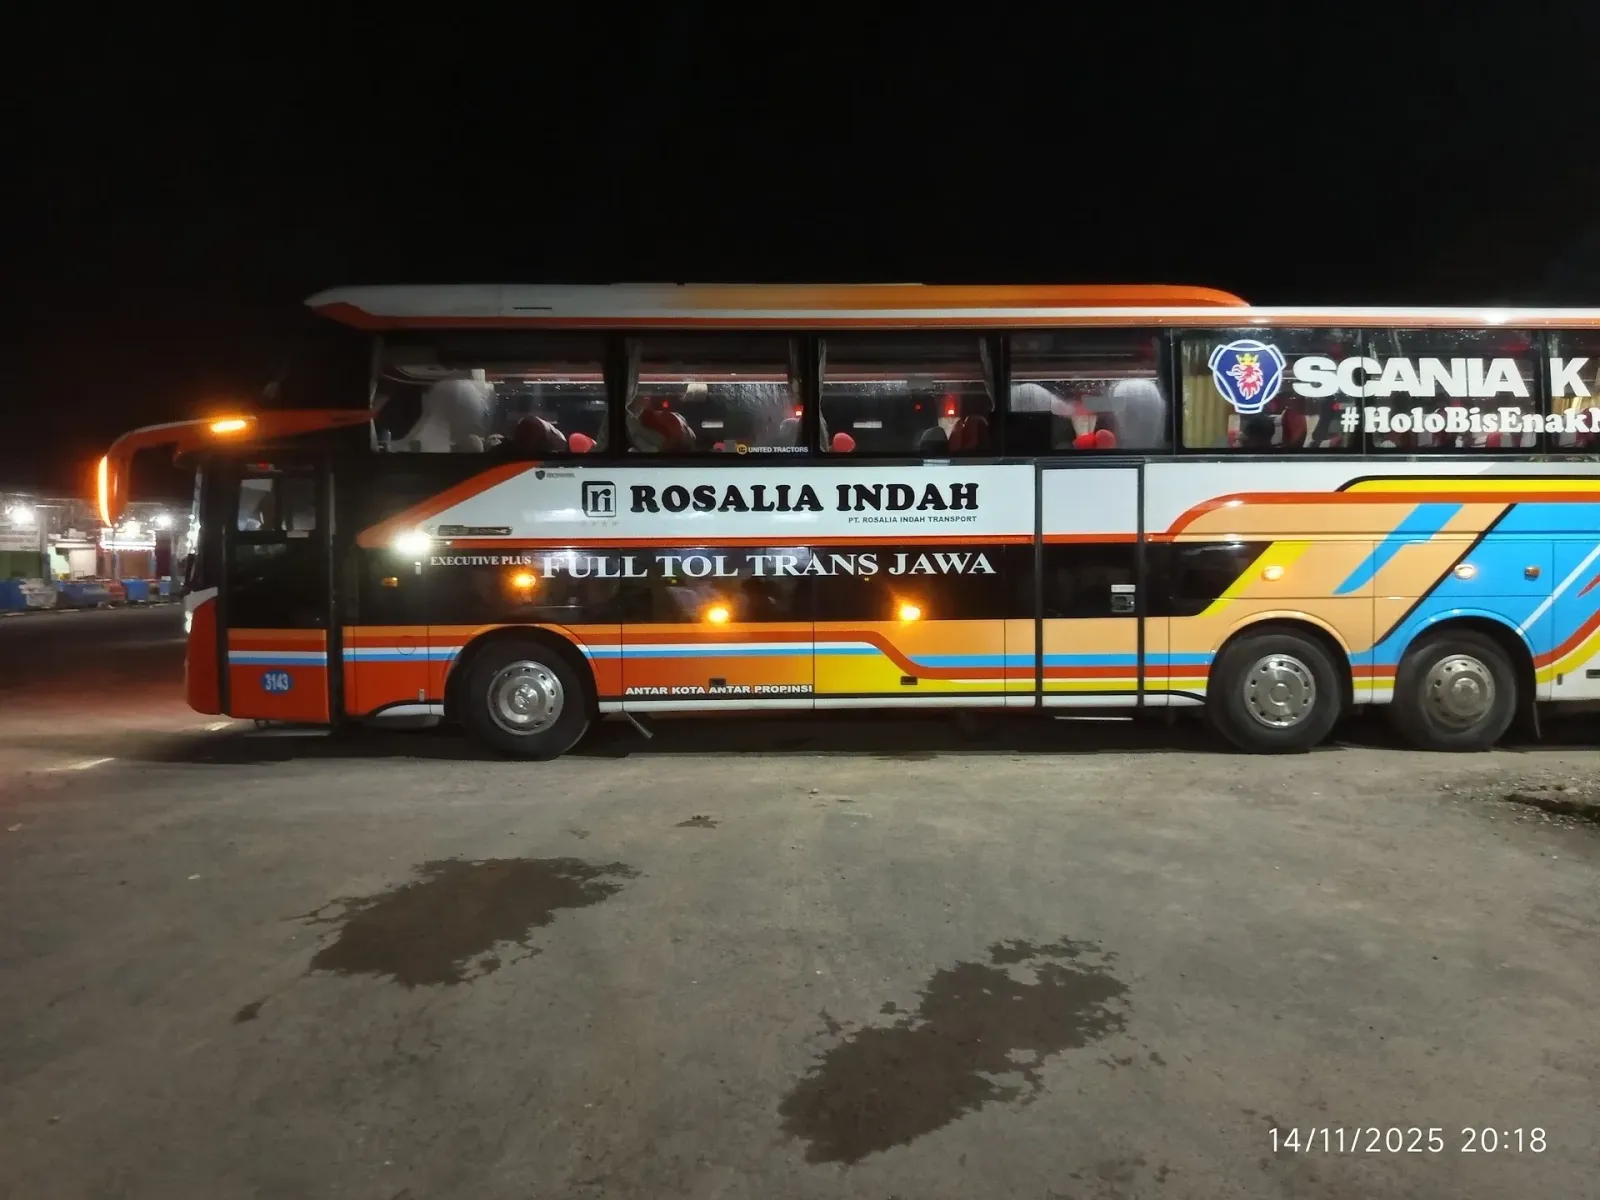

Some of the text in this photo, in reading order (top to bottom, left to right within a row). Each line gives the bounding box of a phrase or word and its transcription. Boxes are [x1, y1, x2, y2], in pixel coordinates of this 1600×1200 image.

[1292, 356, 1592, 398] SCANIA K
[630, 483, 980, 513] ROSALIA INDAH
[848, 516, 860, 524] PT.
[928, 515, 977, 523] TRANSPORT
[430, 555, 532, 566] EXECUTIVE PLUS
[540, 552, 997, 578] FULL TOL TRANS JAWA
[264, 673, 289, 690] 3143
[625, 684, 812, 695] ANTAR KOTA ANTAR PROPINSI
